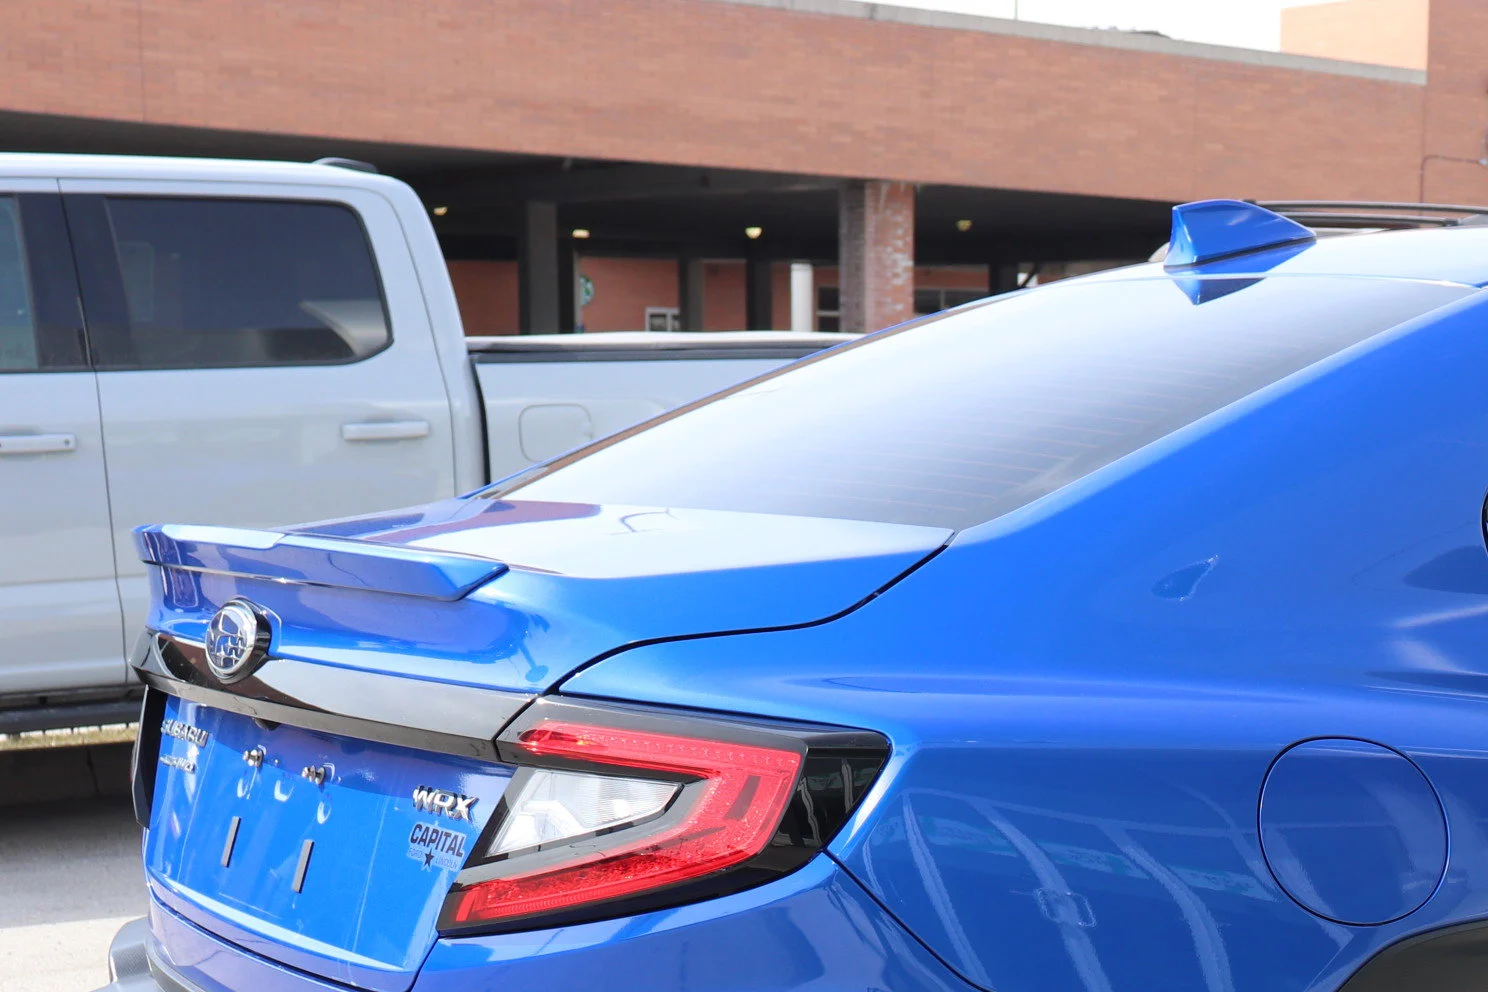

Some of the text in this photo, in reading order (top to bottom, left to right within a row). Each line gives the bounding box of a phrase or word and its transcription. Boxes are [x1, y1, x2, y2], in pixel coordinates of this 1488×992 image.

[160, 719, 208, 748] SUBARU
[412, 785, 479, 822] WRX
[410, 823, 466, 858] CAPITAL
